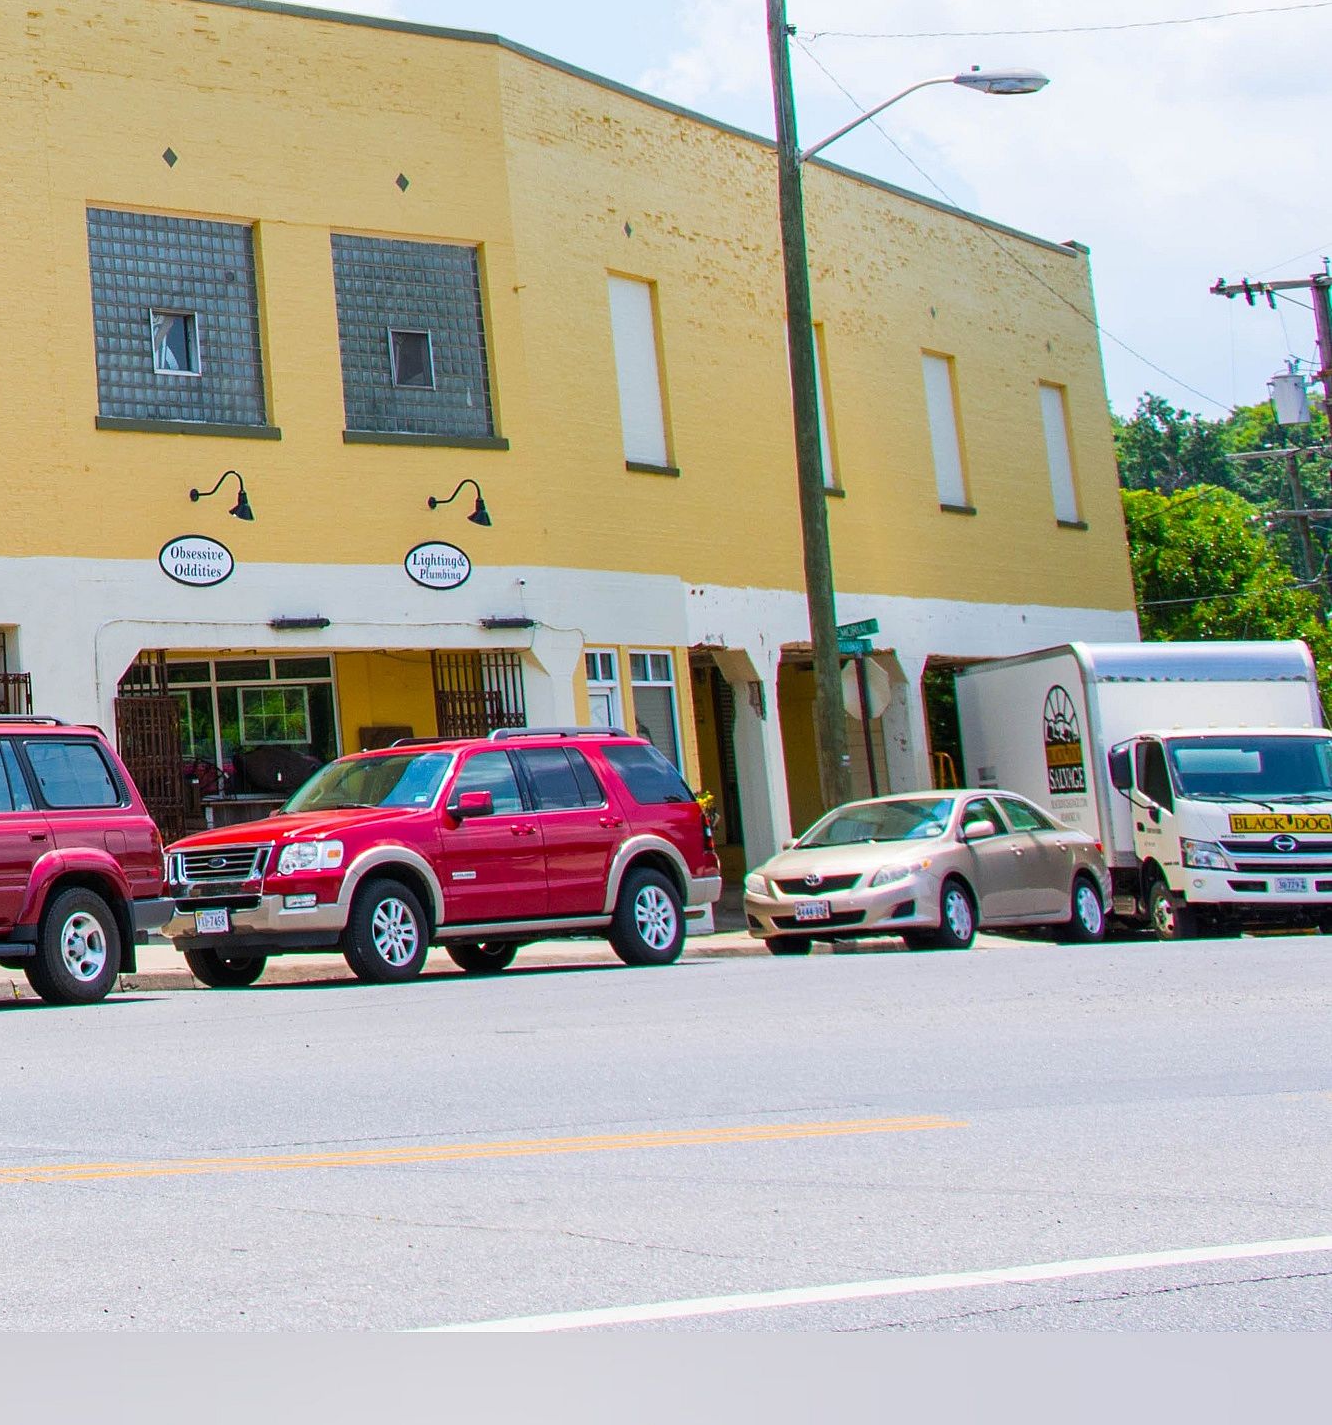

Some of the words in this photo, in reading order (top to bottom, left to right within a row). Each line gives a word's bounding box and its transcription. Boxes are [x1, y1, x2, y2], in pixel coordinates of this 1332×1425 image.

[170, 545, 224, 562] Obsessive
[173, 562, 223, 578] Oddities
[419, 567, 461, 580] Plumbing
[1049, 767, 1085, 790] SALVAGE
[1234, 816, 1285, 831] BLACK
[1294, 816, 1331, 831] DOG
